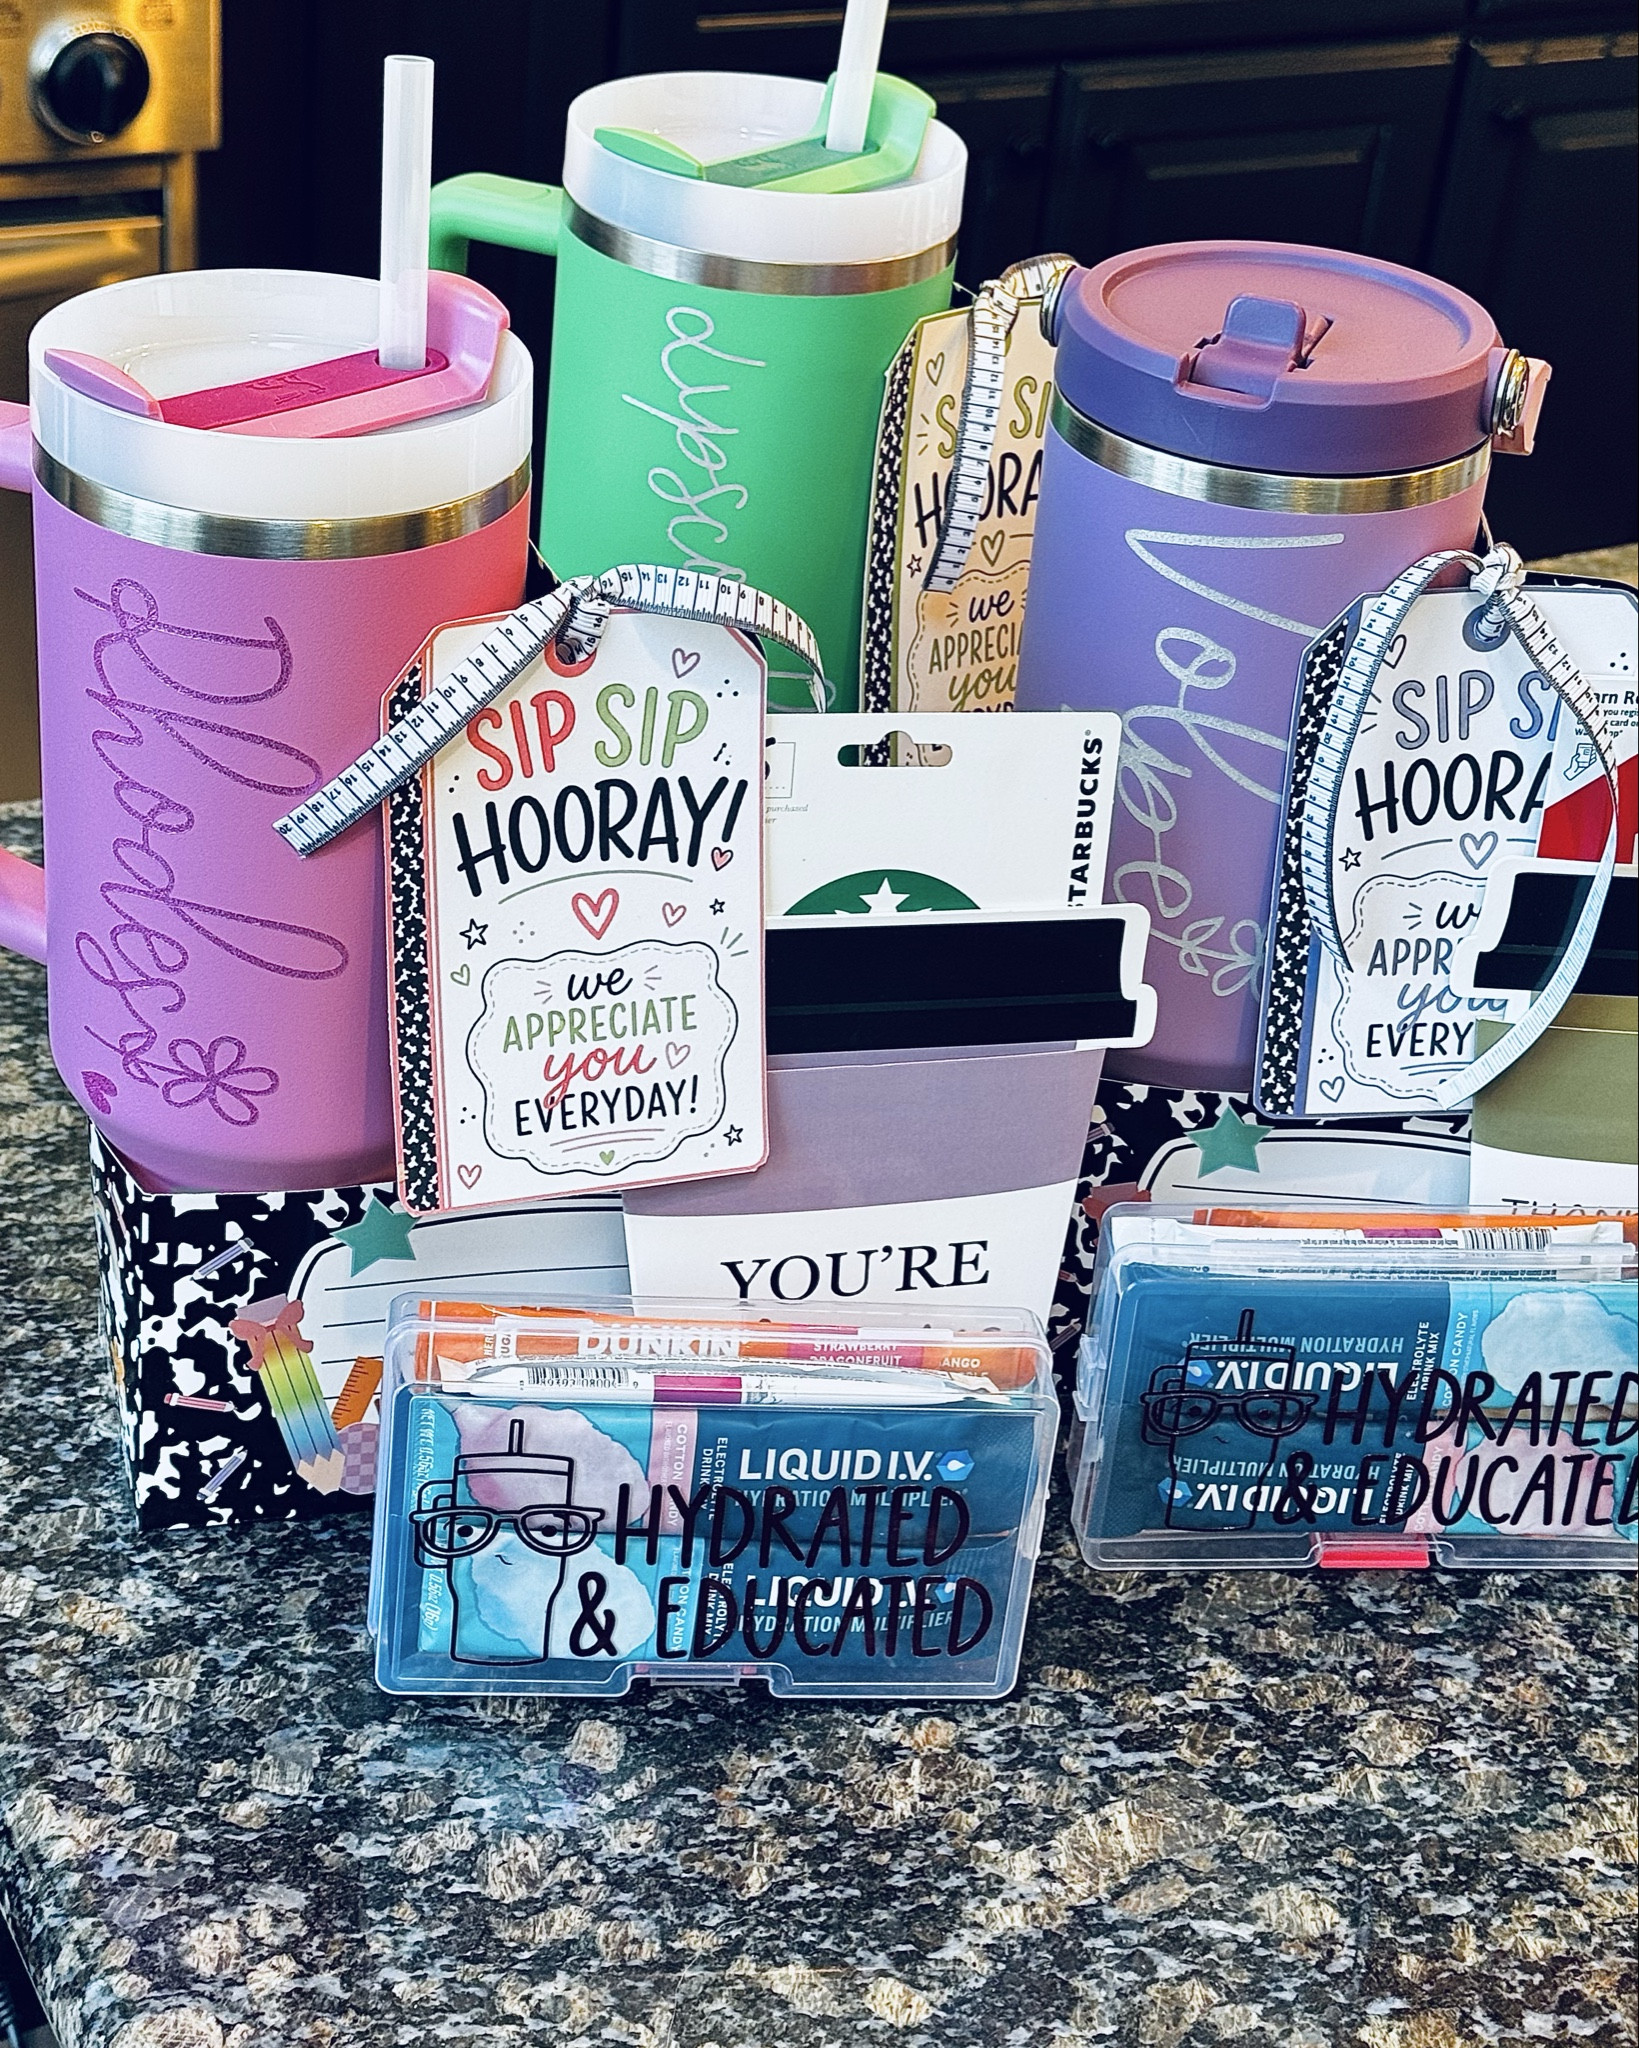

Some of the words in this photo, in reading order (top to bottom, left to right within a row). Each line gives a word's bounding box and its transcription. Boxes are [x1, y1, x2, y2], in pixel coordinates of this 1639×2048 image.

[992, 356, 999, 364] 13
[990, 374, 999, 382] 12
[989, 391, 997, 400] 11
[985, 408, 994, 418] 10
[1009, 376, 1052, 439] SI
[621, 571, 633, 582] 15
[642, 571, 650, 581] 14
[657, 573, 667, 584] 13
[678, 576, 690, 586] 12
[1402, 572, 1413, 580] 11
[602, 578, 613, 589] 16
[699, 580, 709, 590] 11
[720, 584, 731, 595] 10
[740, 590, 746, 599] 9
[1390, 585, 1400, 595] 12
[968, 589, 1015, 623] we
[1376, 601, 1387, 611] 13
[519, 613, 529, 622] 5
[1367, 618, 1376, 629] 14
[505, 628, 514, 636] 6
[928, 622, 1022, 674] APPRECI
[1357, 637, 1366, 647] 15
[490, 644, 499, 653] 7
[1549, 644, 1558, 655] 13
[475, 658, 484, 667] 8
[1348, 656, 1358, 667] 16
[1562, 661, 1571, 671] 12
[460, 674, 468, 683] 9
[1343, 675, 1351, 684] 17
[1574, 675, 1582, 685] 11
[443, 686, 456, 698] 10
[949, 663, 1017, 712] you
[1336, 694, 1344, 706] 18
[1593, 692, 1618, 704] arn
[427, 702, 439, 713] 11
[1392, 669, 1494, 751] SIP
[1509, 669, 1563, 741] SI
[1603, 709, 1619, 717] you
[1620, 709, 1638, 717] regi
[411, 714, 425, 728] 12
[1330, 714, 1338, 724] 19
[1610, 719, 1631, 727] card
[394, 731, 408, 743] 13
[467, 689, 576, 792] SIP
[594, 682, 710, 769] SIP
[1323, 732, 1333, 744] 20
[378, 745, 391, 757] 14
[361, 760, 375, 772] 15
[345, 774, 358, 786] 16
[329, 788, 341, 800] 17
[1355, 750, 1553, 841] HOORA
[312, 801, 324, 812] 18
[765, 803, 809, 814] purchased
[296, 813, 309, 824] 19
[1067, 737, 1103, 907] TARBUCKS
[279, 823, 292, 834] 20
[450, 774, 749, 898] HOORAY!
[1435, 901, 1481, 930] w
[567, 967, 635, 1002] we
[502, 994, 698, 1054] APPRECIATE
[1366, 1022, 1474, 1058] EVERY
[543, 1043, 659, 1111] you
[514, 1074, 700, 1137] EVERYDAY!
[484, 1334, 496, 1357] HER
[1190, 1332, 1296, 1353] MULTPLIER
[1300, 1336, 1404, 1353] HYDRATION
[1427, 1331, 1440, 1353] MIX
[940, 1358, 980, 1368] ANGO
[1442, 1358, 1462, 1407] COON
[1452, 1311, 1468, 1356] CANDY
[1214, 1360, 1259, 1390] I.V.
[1264, 1360, 1399, 1392] LQUID
[673, 1424, 688, 1481] COTTON
[700, 1448, 713, 1486] DRINK
[739, 1448, 882, 1481] LIQUID
[886, 1450, 932, 1481] I.V.
[1279, 1460, 1381, 1480] HDRATON
[709, 1437, 728, 1521] ELECTR
[1273, 1450, 1317, 1526] &
[1193, 1482, 1239, 1511] I.V.
[666, 1485, 679, 1526] NDY
[614, 1483, 970, 1569] HYDRATED
[707, 1572, 720, 1608] DINK
[569, 1570, 618, 1657] &
[656, 1574, 994, 1659] EDUCATED
